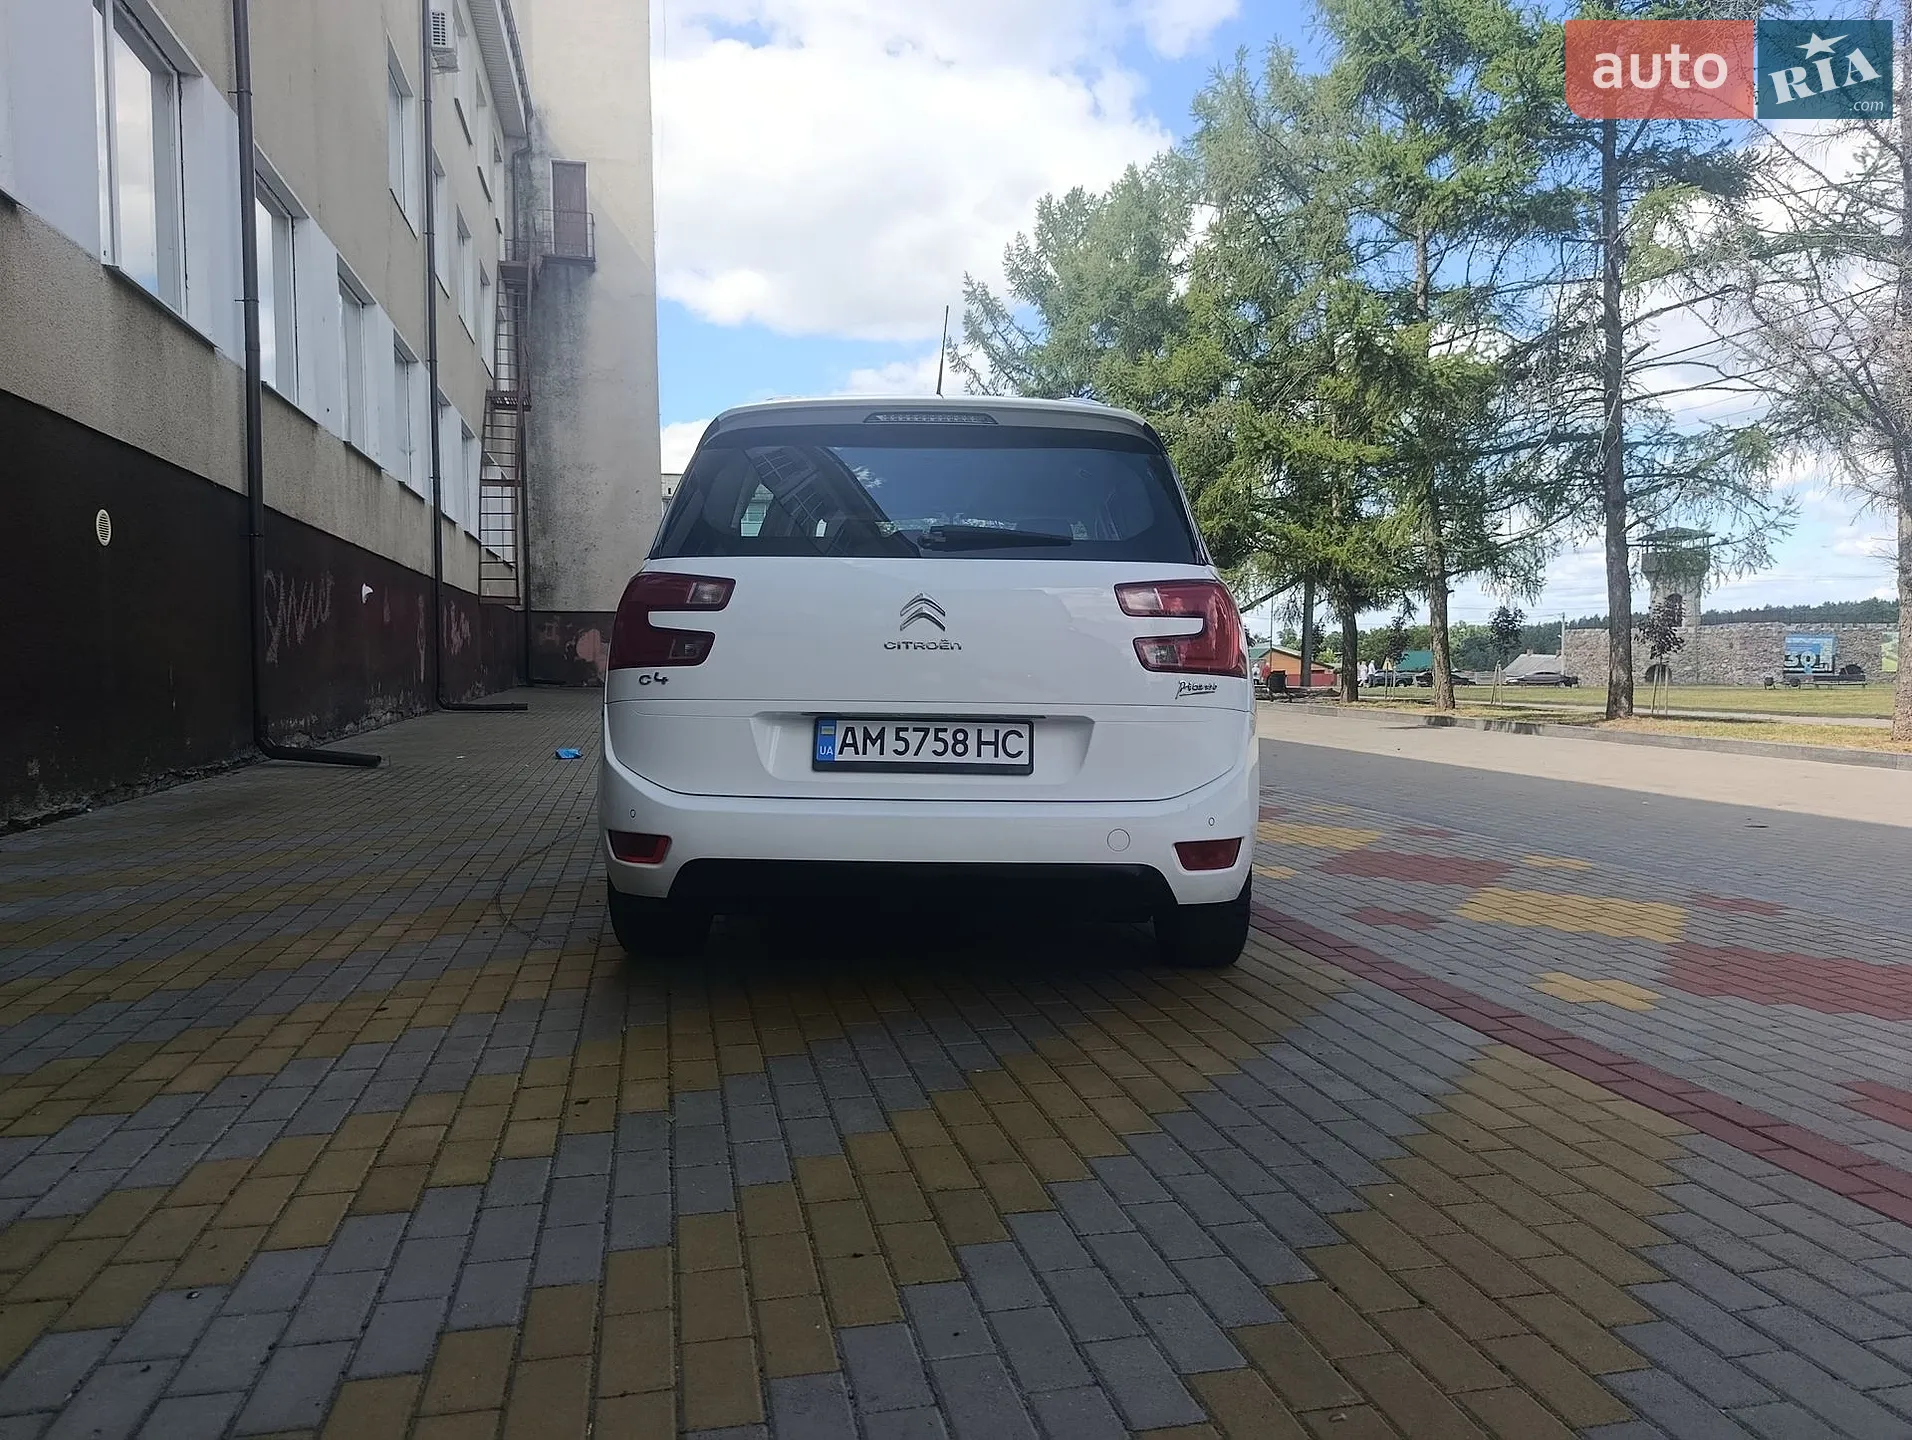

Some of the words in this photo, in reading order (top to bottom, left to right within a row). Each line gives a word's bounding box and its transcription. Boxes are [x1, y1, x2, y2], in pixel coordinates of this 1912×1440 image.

[638, 671, 669, 686] C4
[838, 726, 886, 757] AM
[892, 727, 969, 758] 5758
[976, 728, 1025, 759] HC
[819, 745, 834, 756] UA
